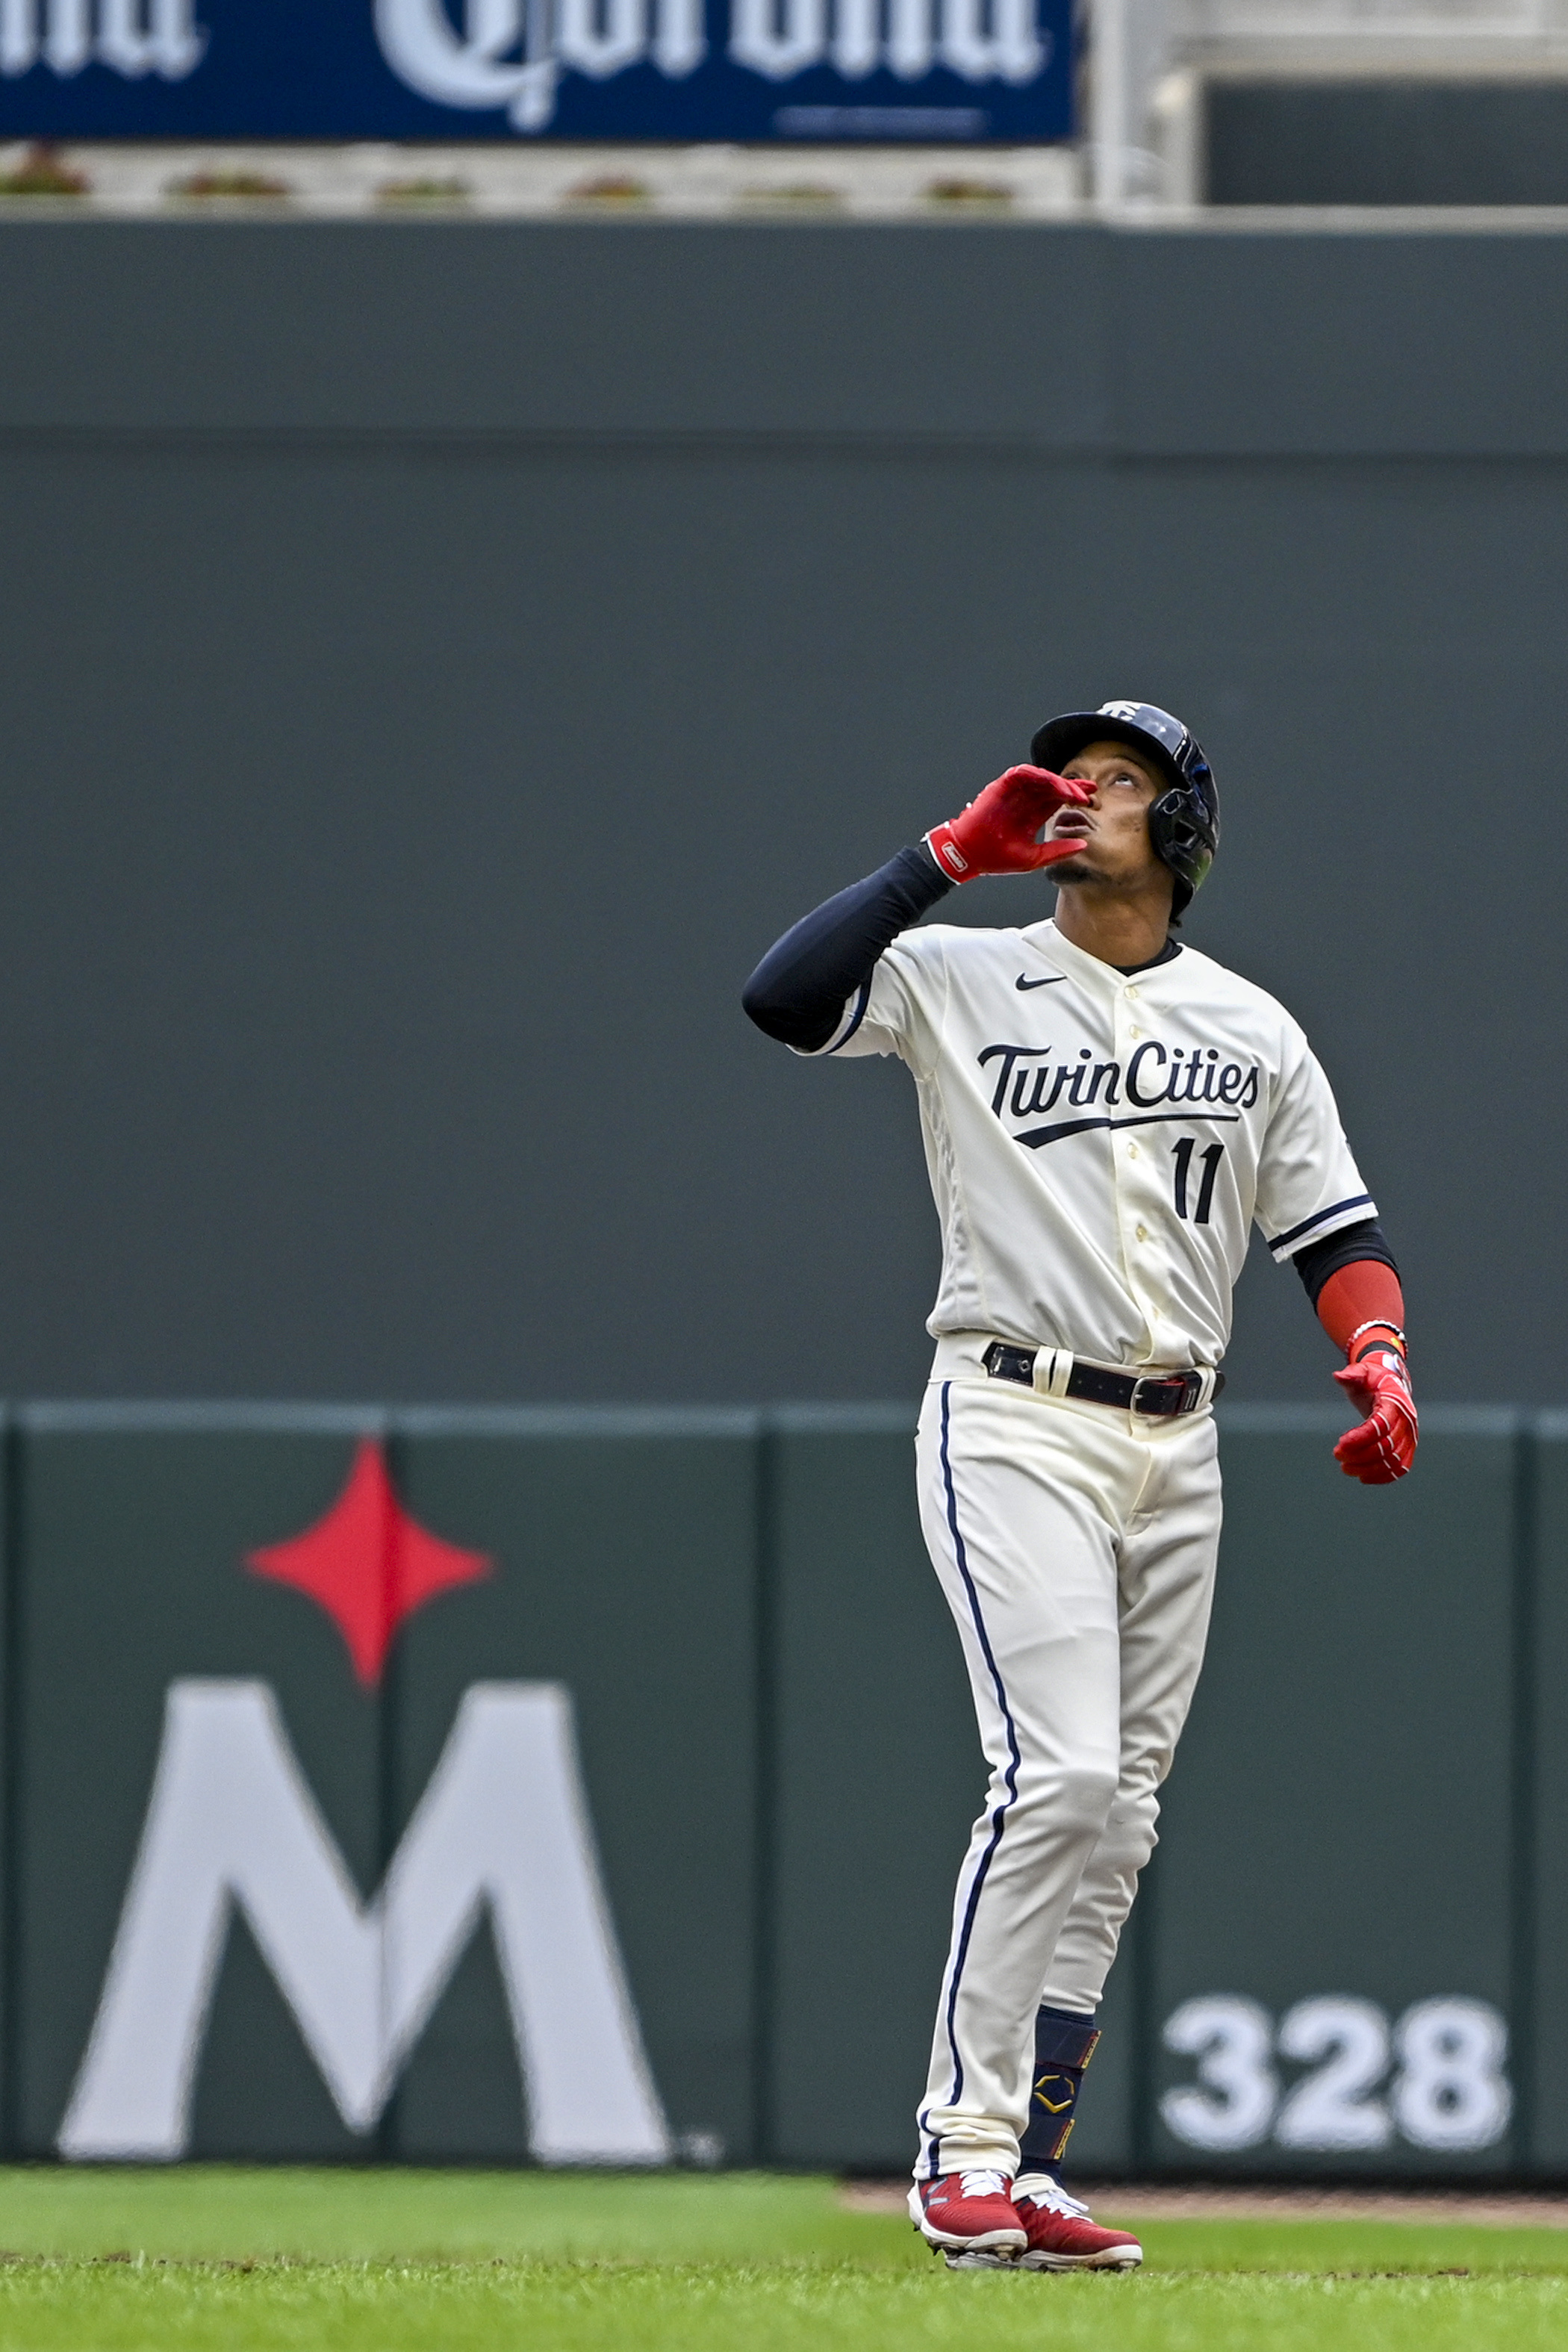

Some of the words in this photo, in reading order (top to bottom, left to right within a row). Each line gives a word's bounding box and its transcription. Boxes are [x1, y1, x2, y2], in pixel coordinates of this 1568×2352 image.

[977, 1044, 1120, 1119] Twin
[1125, 1040, 1259, 1109] Cities
[1172, 1137, 1225, 1225] 11
[57, 1677, 670, 2162] M
[1160, 1994, 1511, 2153] 328
